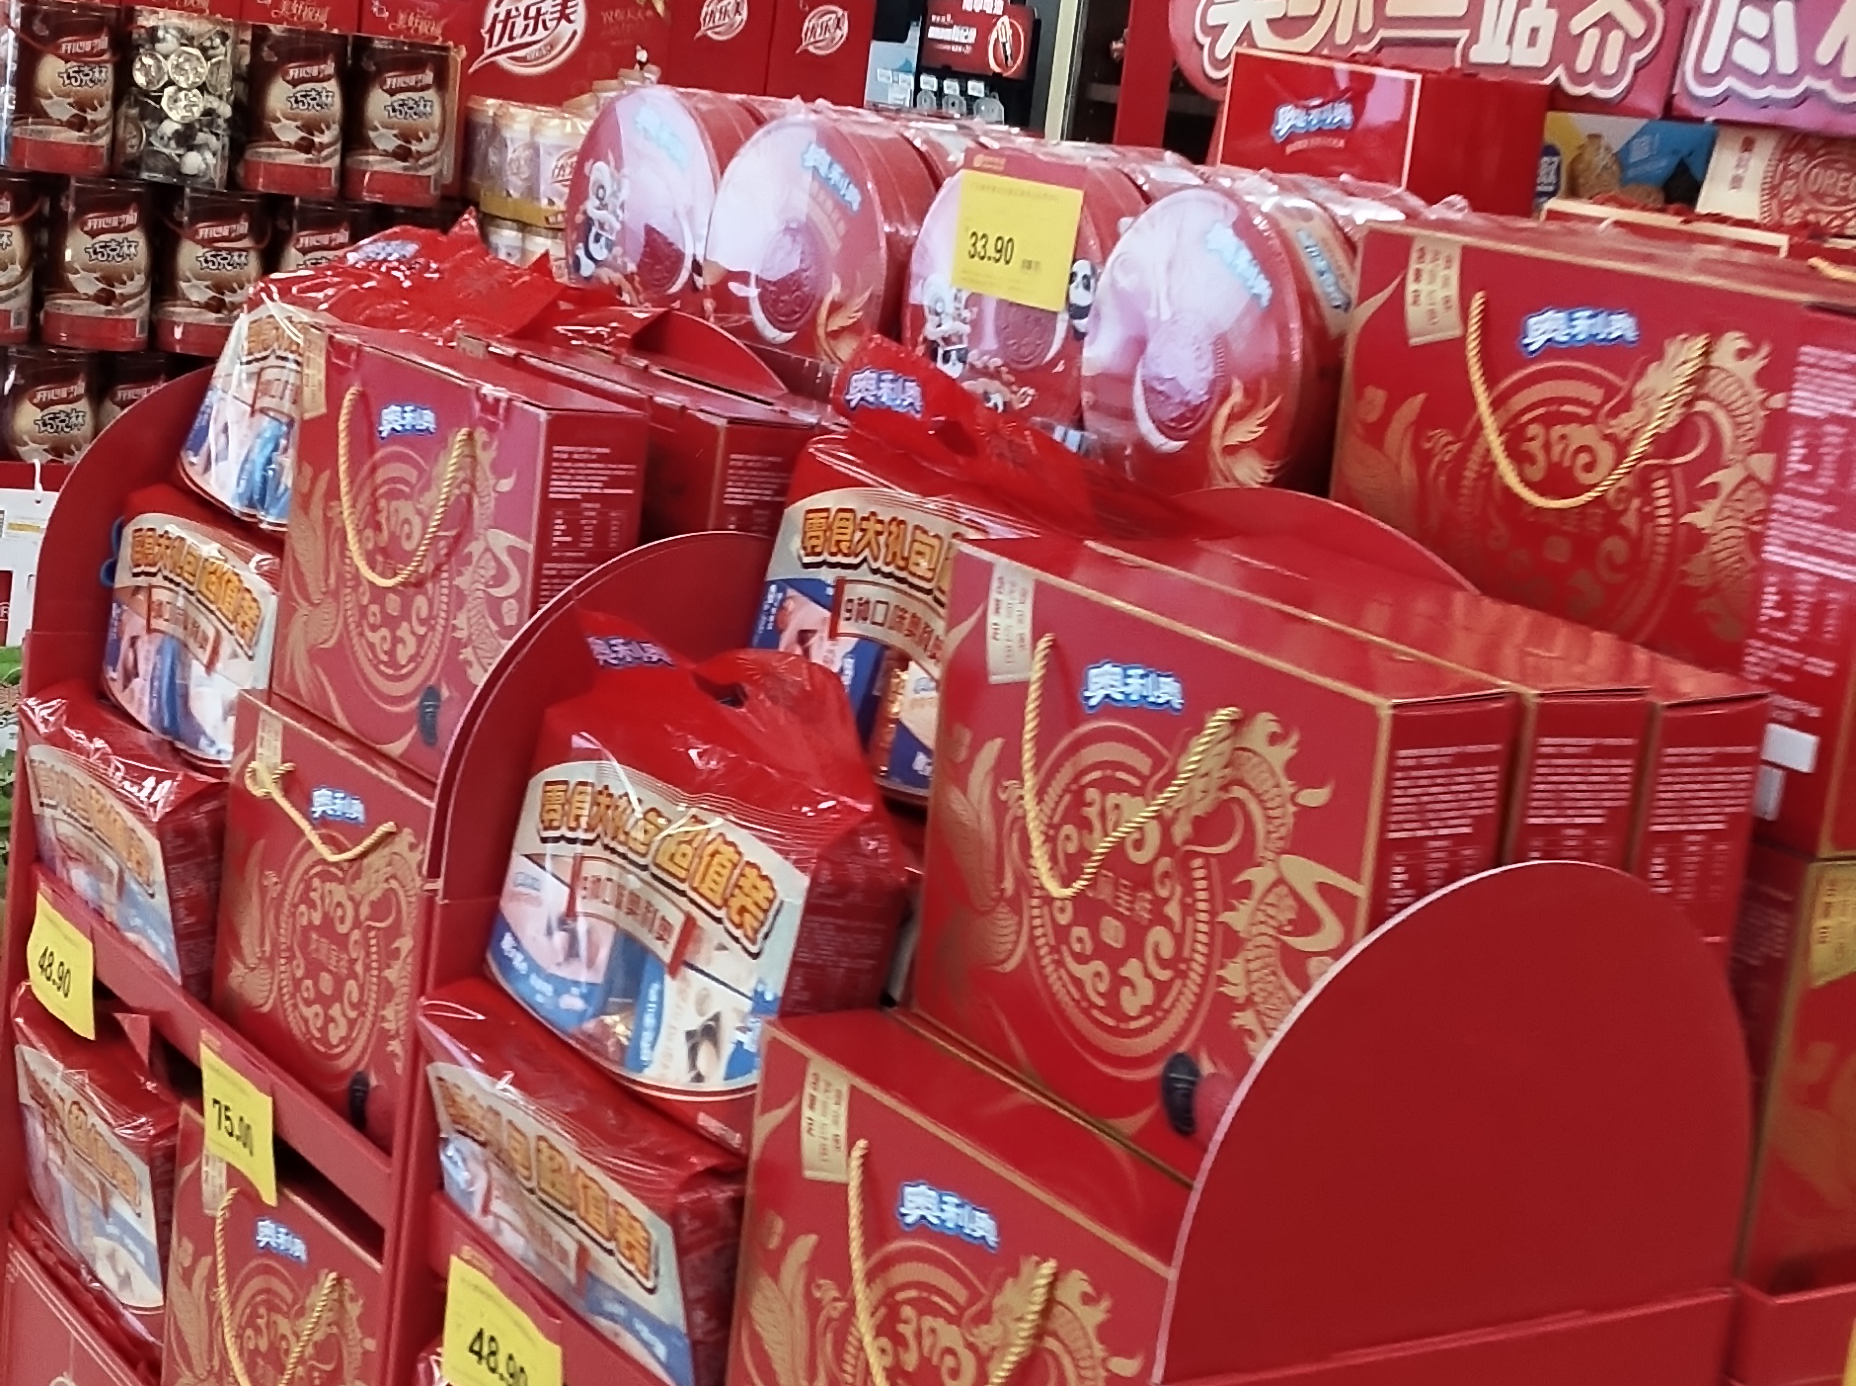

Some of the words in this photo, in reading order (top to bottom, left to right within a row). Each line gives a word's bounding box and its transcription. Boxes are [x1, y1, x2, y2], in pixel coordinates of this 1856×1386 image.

[968, 230, 1015, 266] 33.90
[846, 368, 924, 418] 奥利奥
[801, 506, 950, 591] 零食大礼包
[37, 945, 72, 999] 48.90
